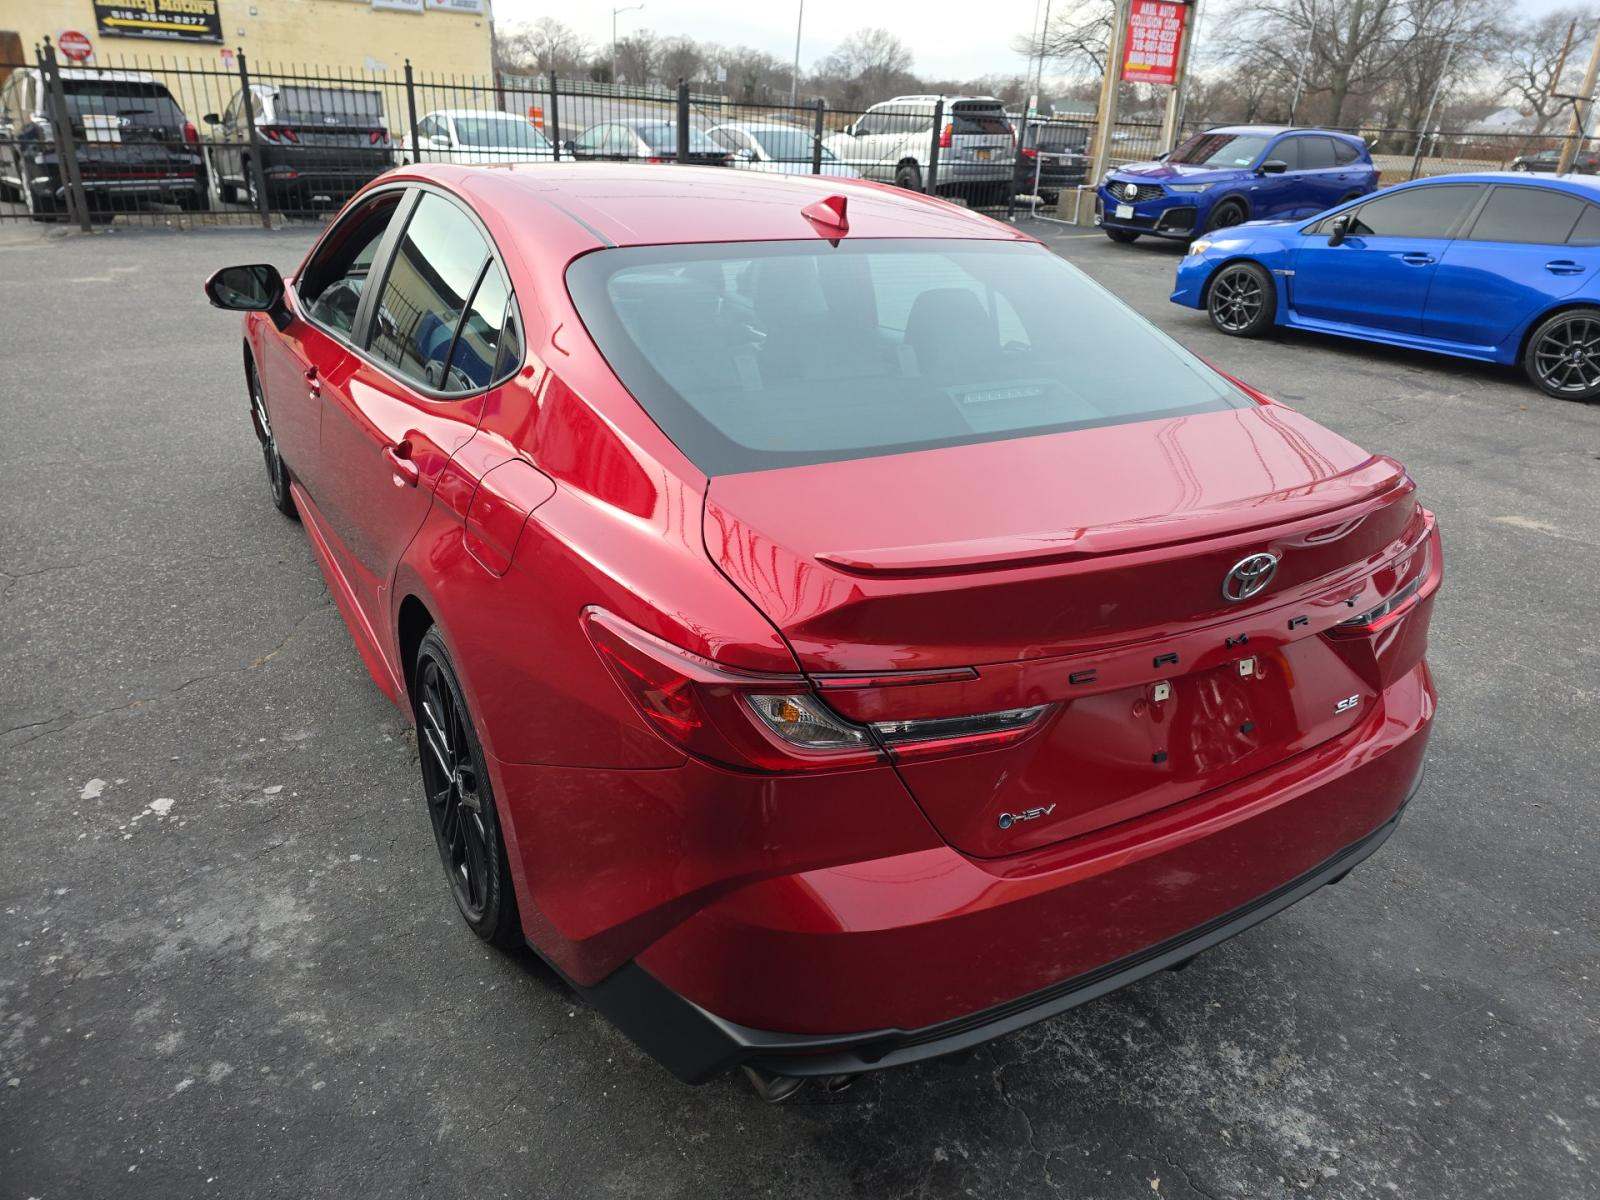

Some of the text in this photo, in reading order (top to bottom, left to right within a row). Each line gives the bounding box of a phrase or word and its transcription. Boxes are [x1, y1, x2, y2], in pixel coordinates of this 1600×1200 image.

[1130, 14, 1162, 29] COLLISION
[1068, 595, 1362, 685] CAMRY
[1334, 693, 1360, 714] SE
